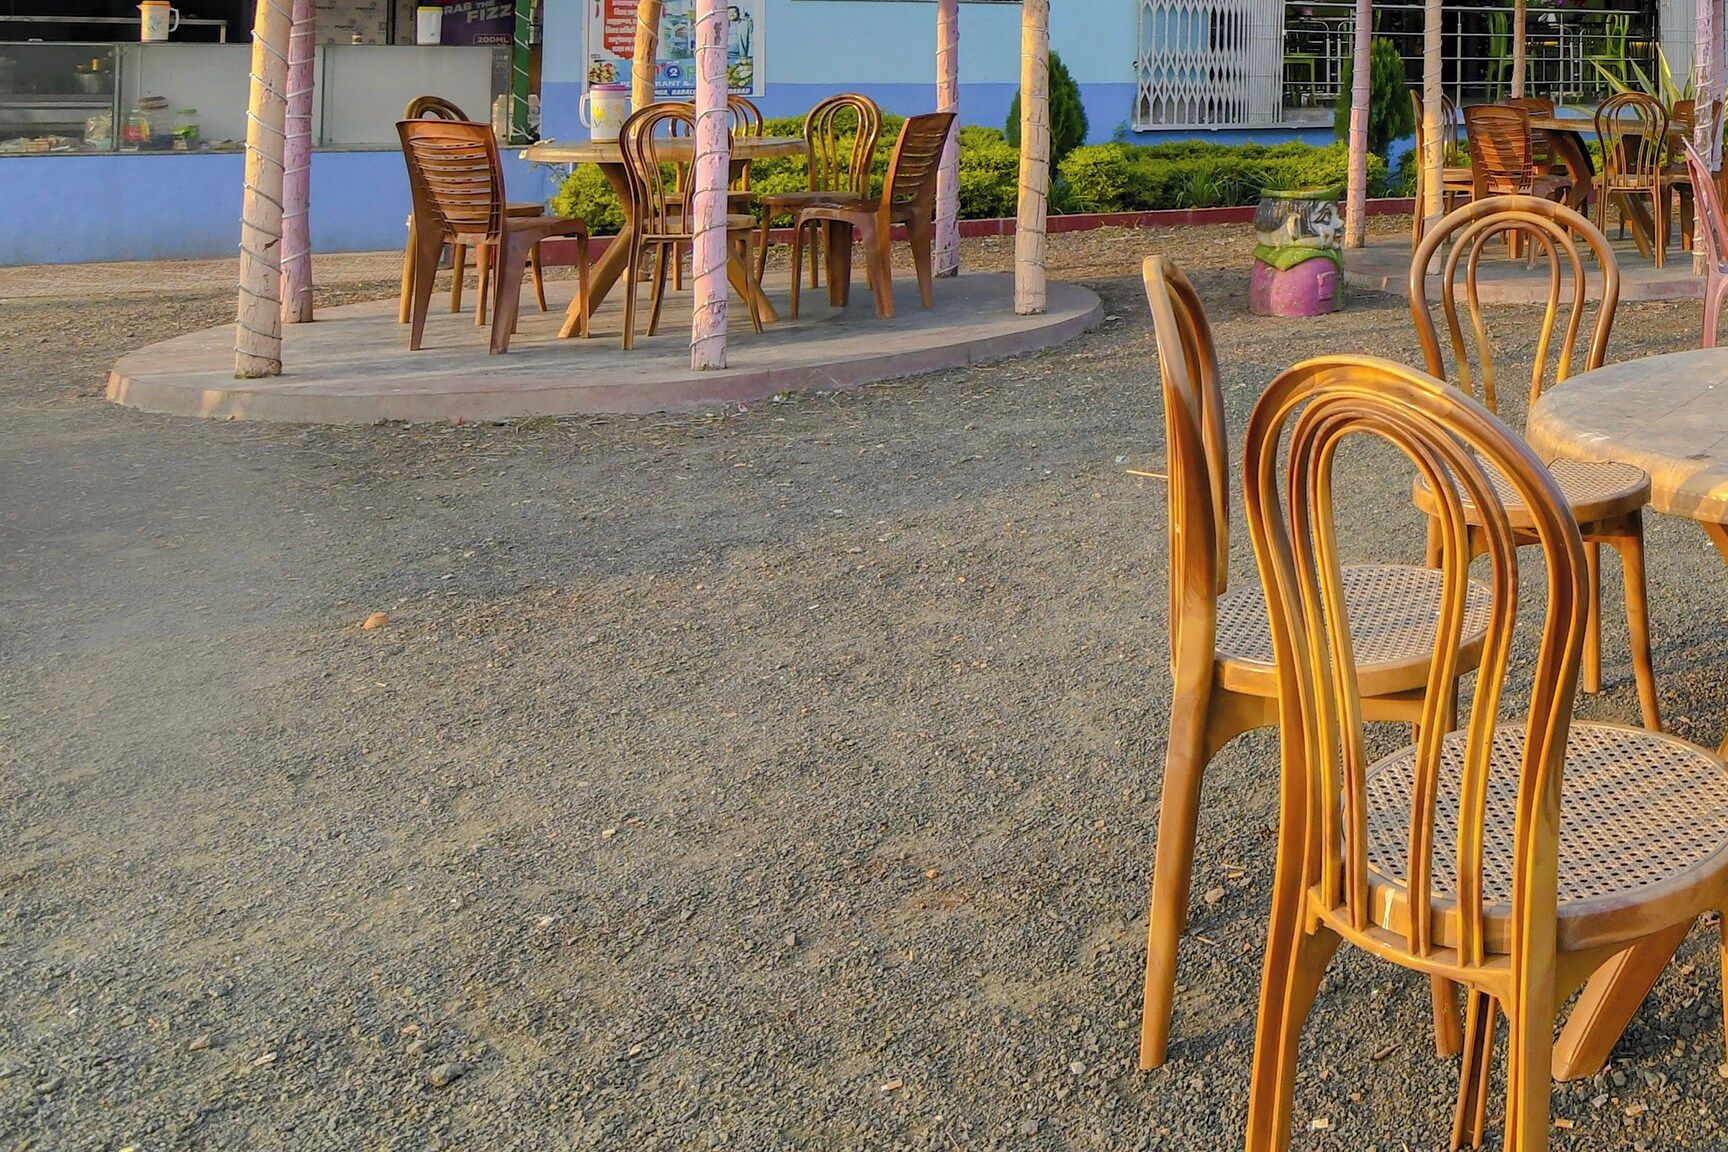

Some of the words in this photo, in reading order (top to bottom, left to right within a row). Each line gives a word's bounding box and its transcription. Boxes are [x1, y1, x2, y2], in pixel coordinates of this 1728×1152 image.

[475, 0, 496, 9] THE
[466, 3, 512, 24] FIZZ
[477, 36, 509, 45] 200ML
